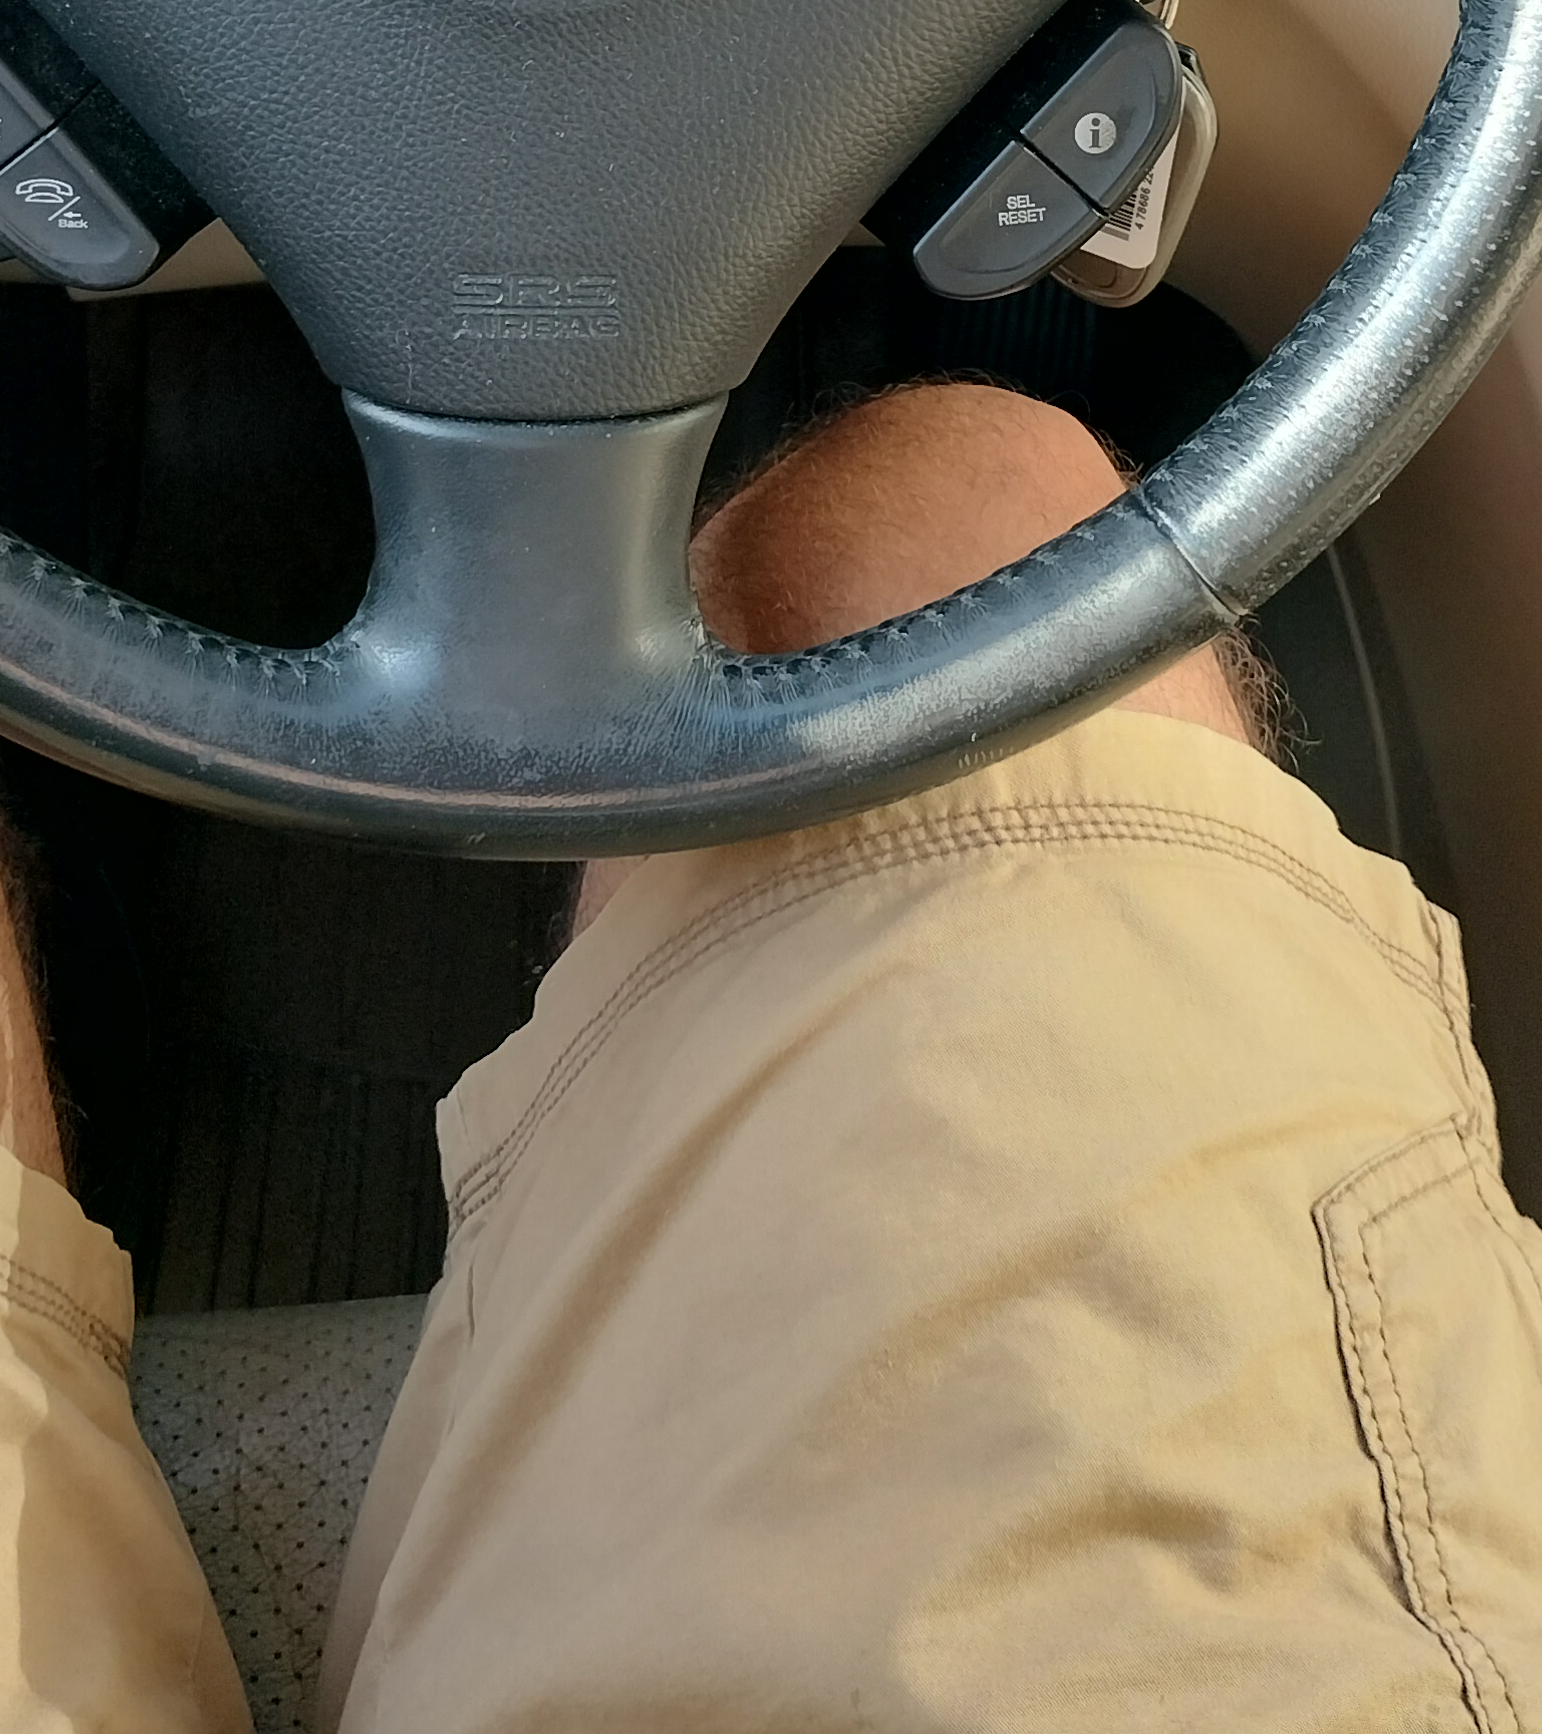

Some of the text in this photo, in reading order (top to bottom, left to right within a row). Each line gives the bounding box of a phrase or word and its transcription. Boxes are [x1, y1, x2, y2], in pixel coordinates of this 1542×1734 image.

[1006, 195, 1036, 209] SEL
[1135, 187, 1151, 221] 78686
[58, 218, 89, 231] Back
[998, 207, 1047, 227] RESET
